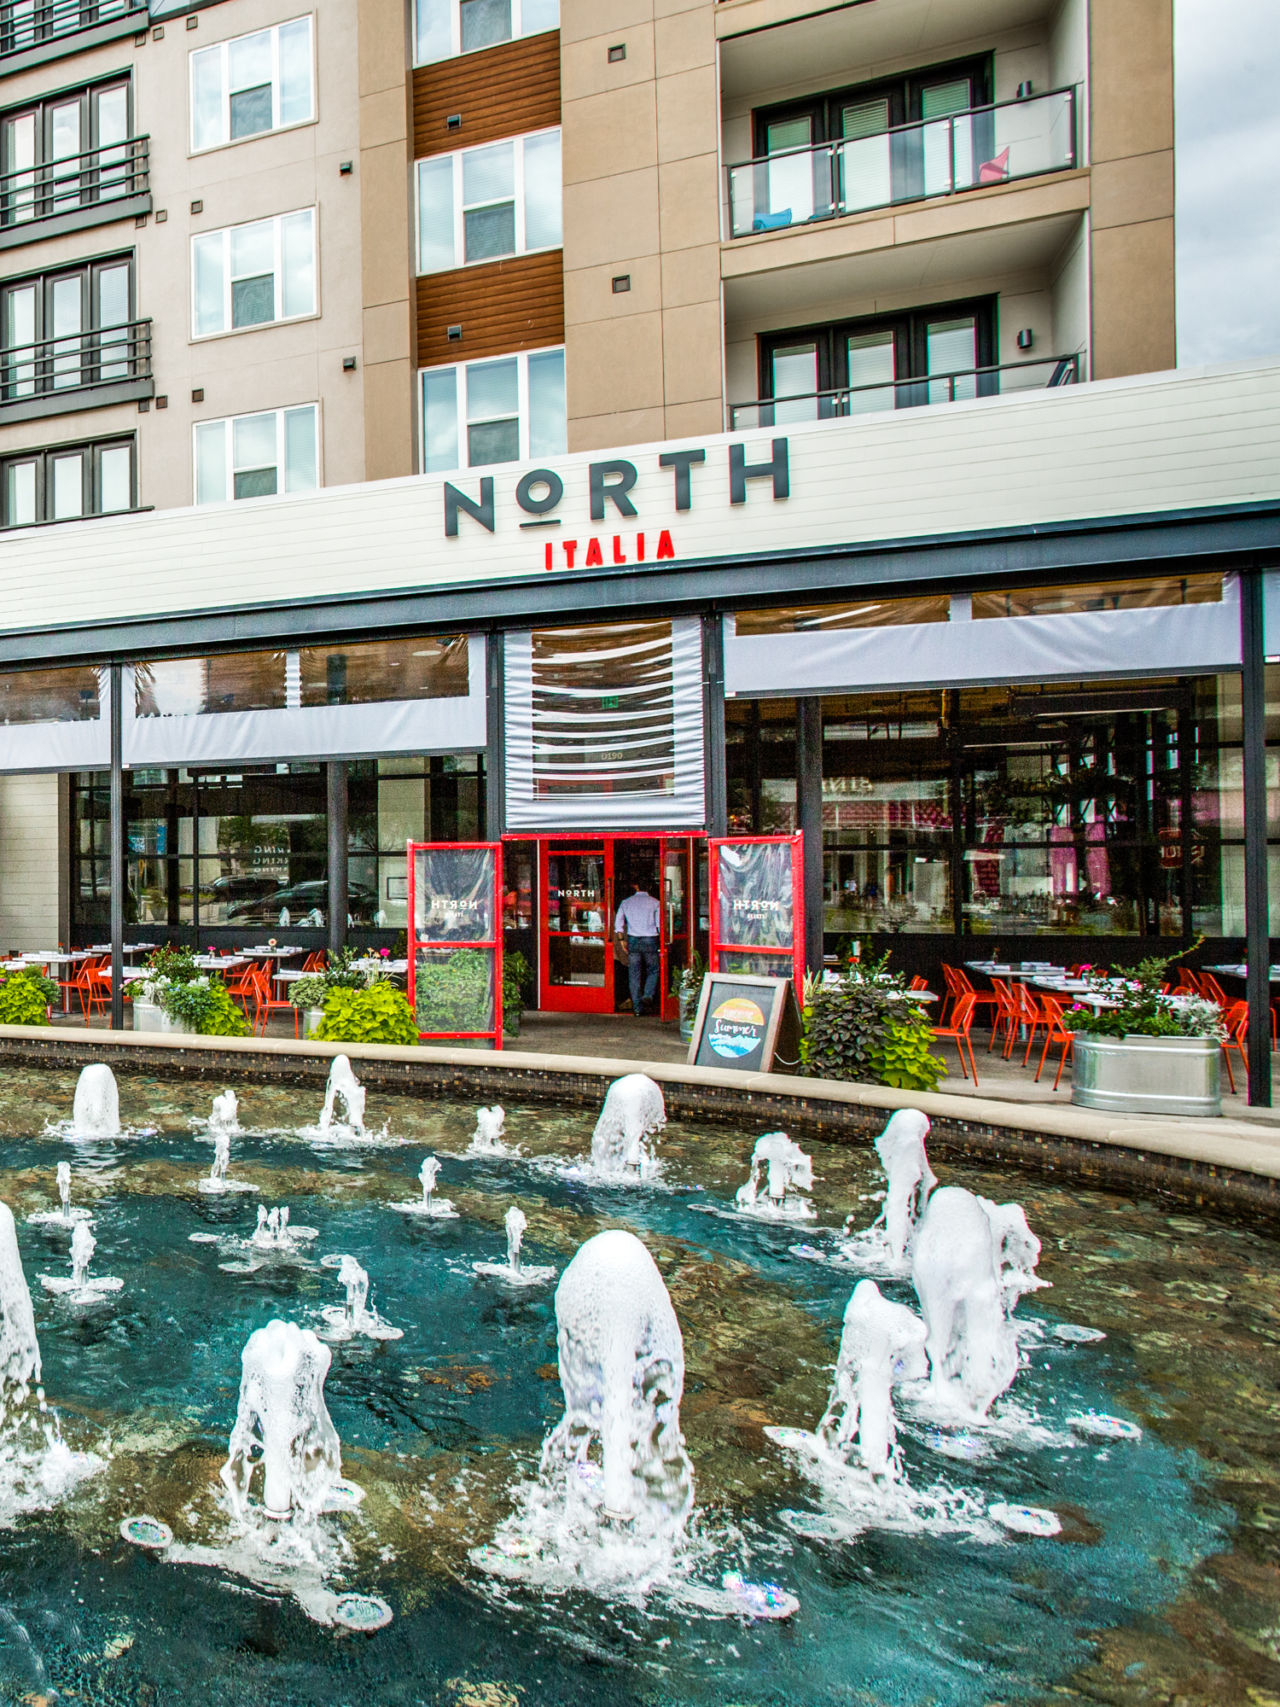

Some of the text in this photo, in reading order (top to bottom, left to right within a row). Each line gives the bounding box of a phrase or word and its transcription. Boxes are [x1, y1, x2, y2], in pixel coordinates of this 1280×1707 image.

[443, 437, 790, 537] NORTH
[544, 529, 675, 571] ITALIA
[601, 752, 623, 760] D190
[557, 889, 595, 898] NORTH
